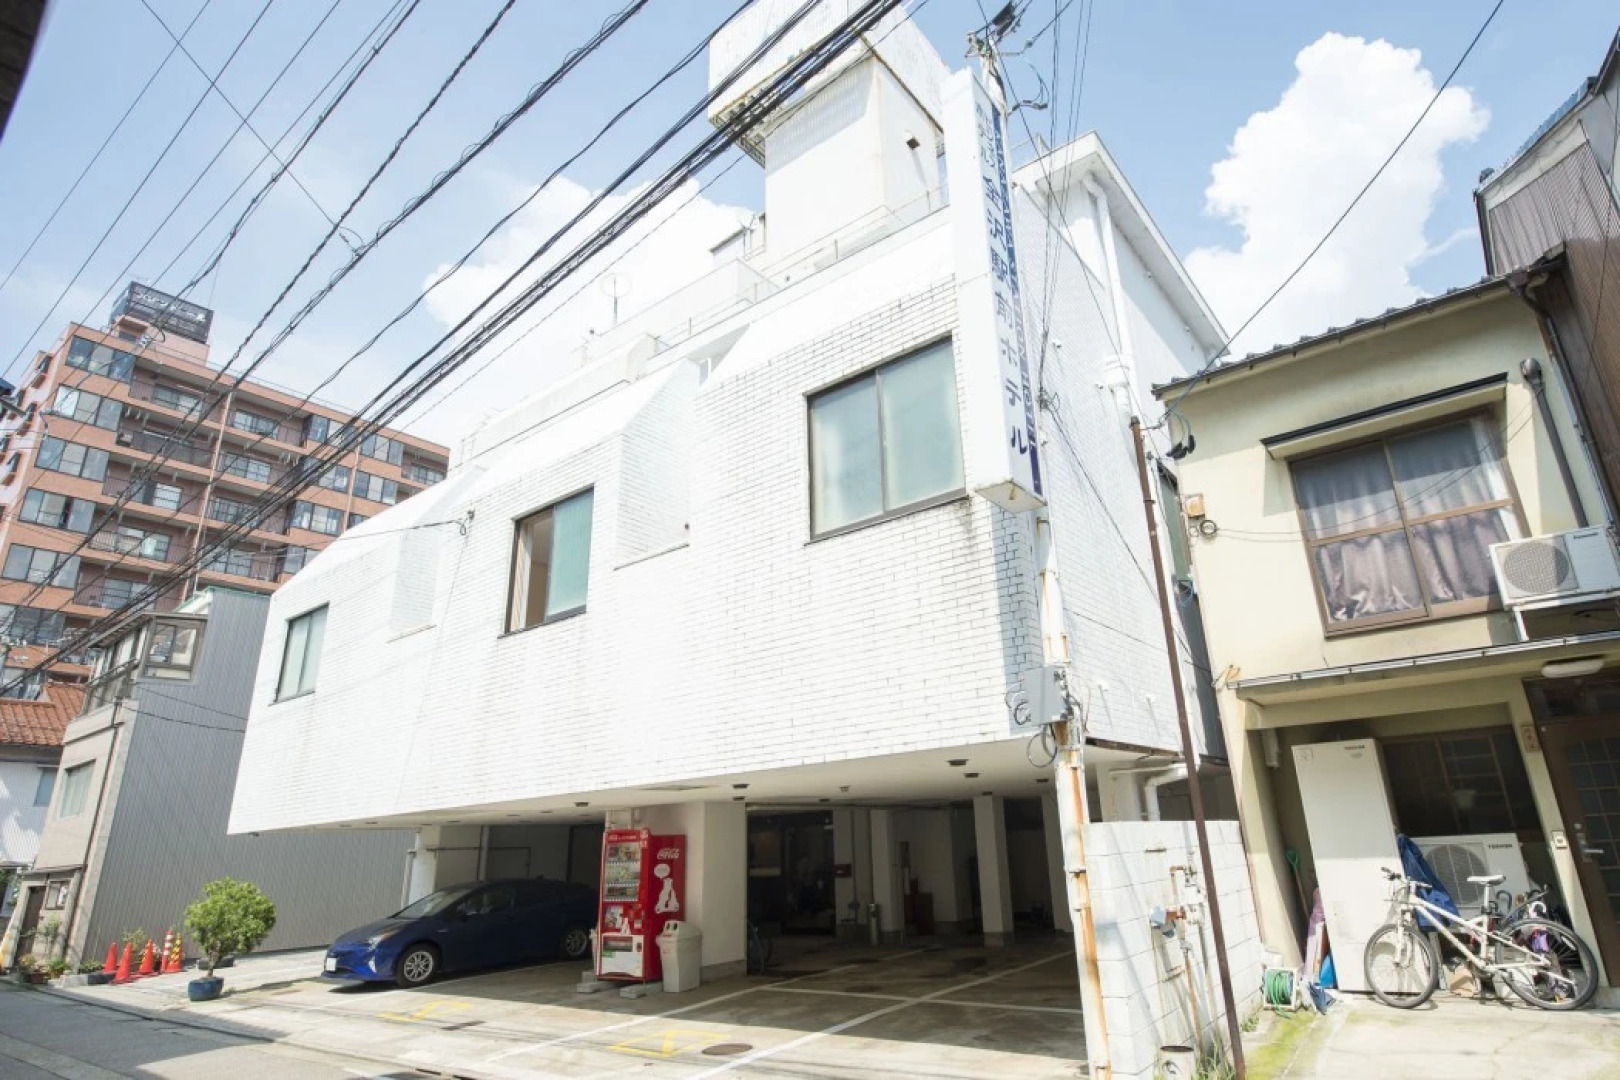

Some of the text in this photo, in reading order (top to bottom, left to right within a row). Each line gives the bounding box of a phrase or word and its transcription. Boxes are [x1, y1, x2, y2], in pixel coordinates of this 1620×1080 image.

[982, 175, 1028, 455] 金沢駅前ホテル
